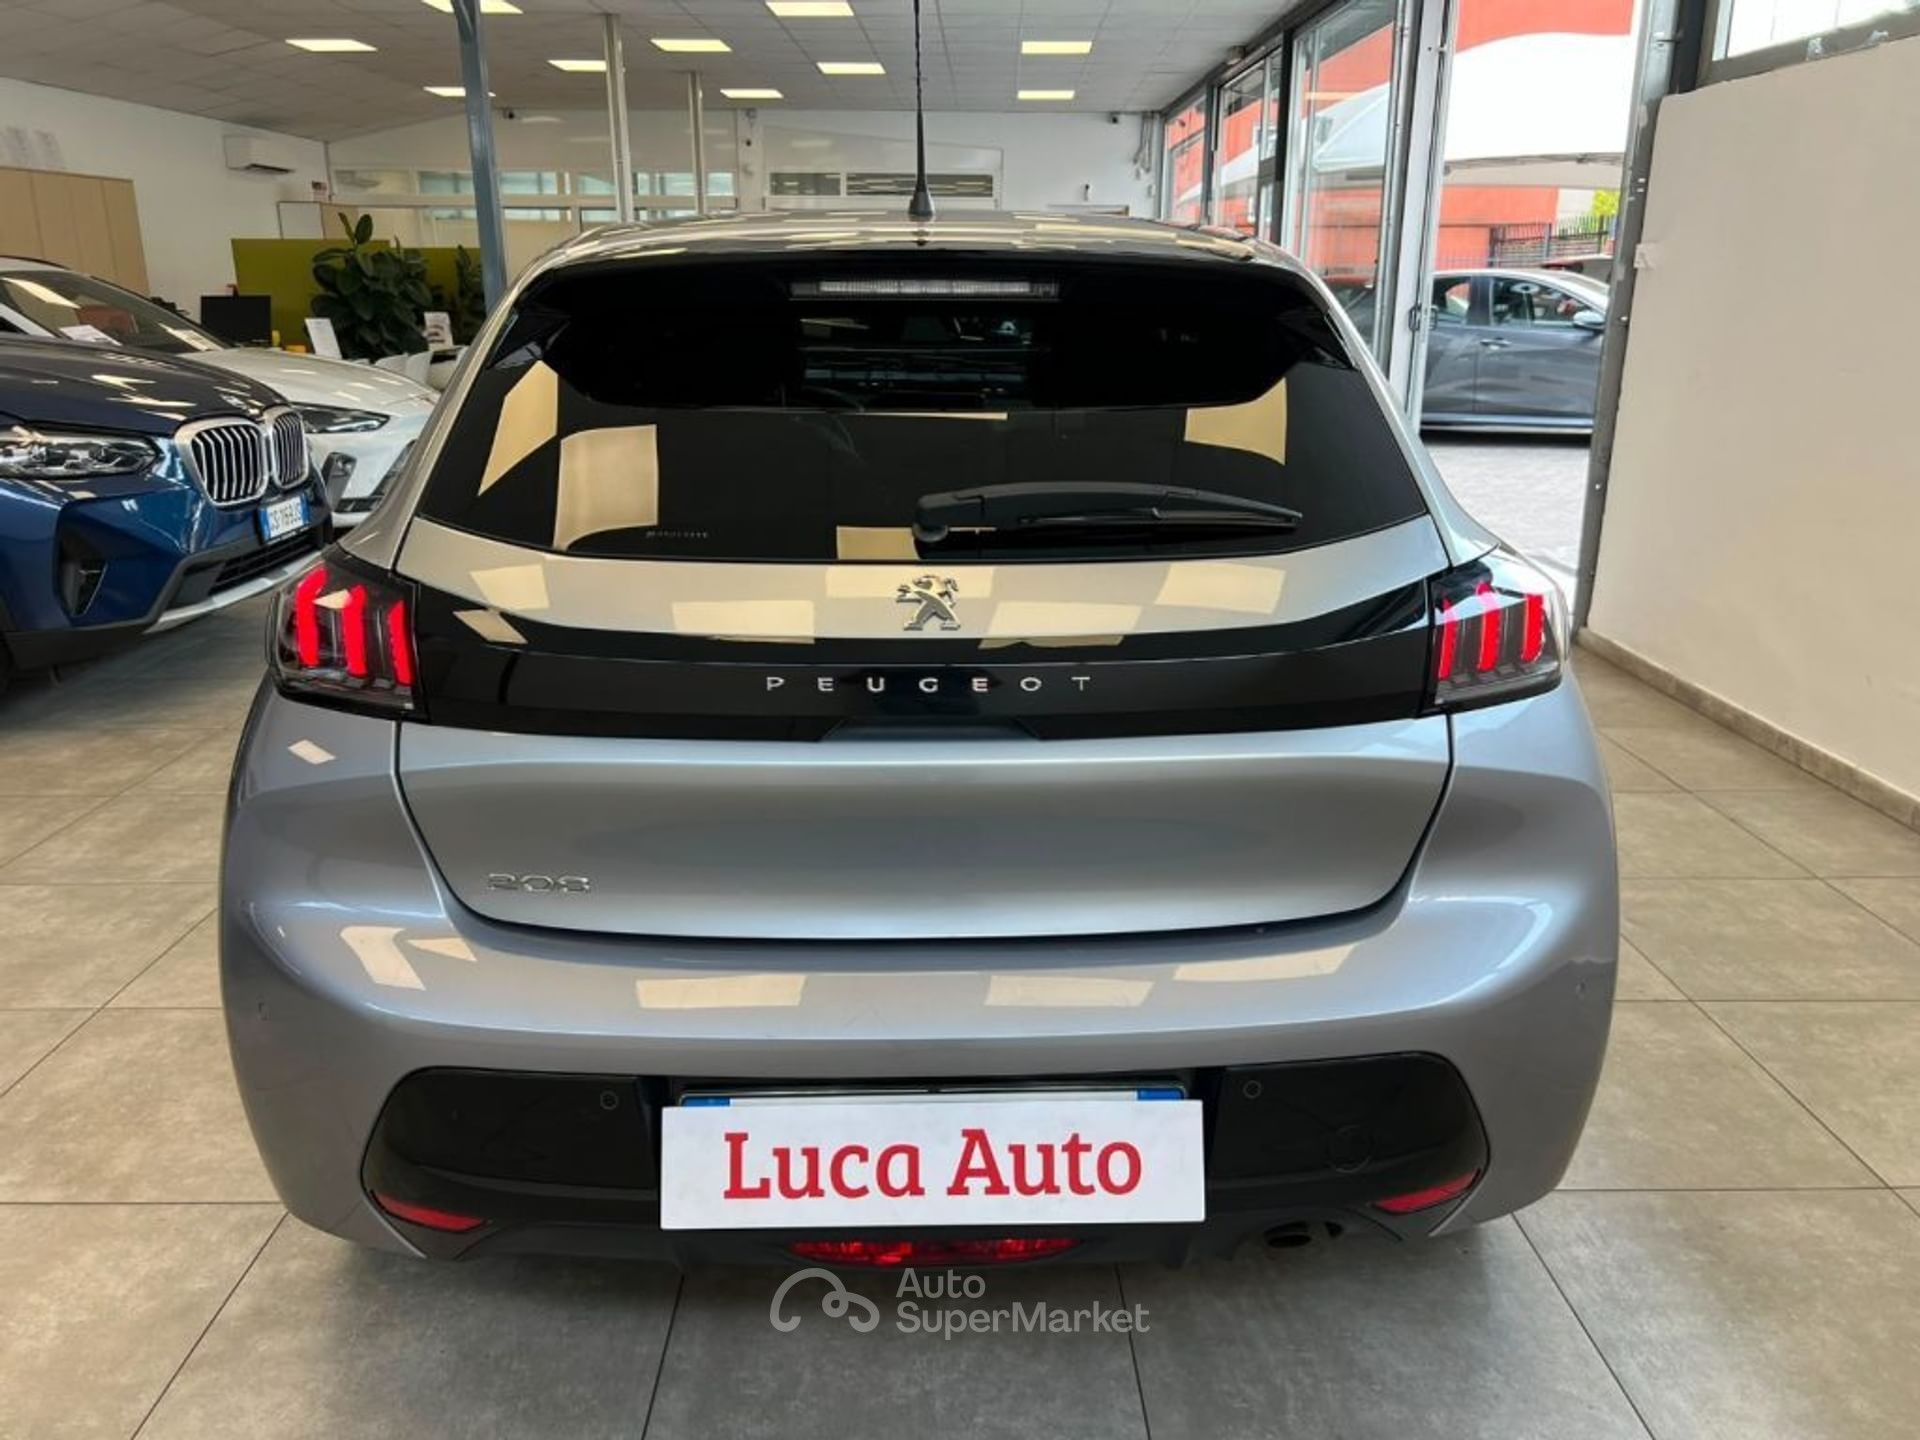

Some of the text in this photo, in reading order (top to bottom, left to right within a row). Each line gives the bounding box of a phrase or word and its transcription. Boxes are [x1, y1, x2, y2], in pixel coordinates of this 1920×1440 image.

[766, 676, 1091, 693] PEUGEOT
[487, 873, 591, 893] 208
[723, 1128, 1142, 1200] Luca Auto
